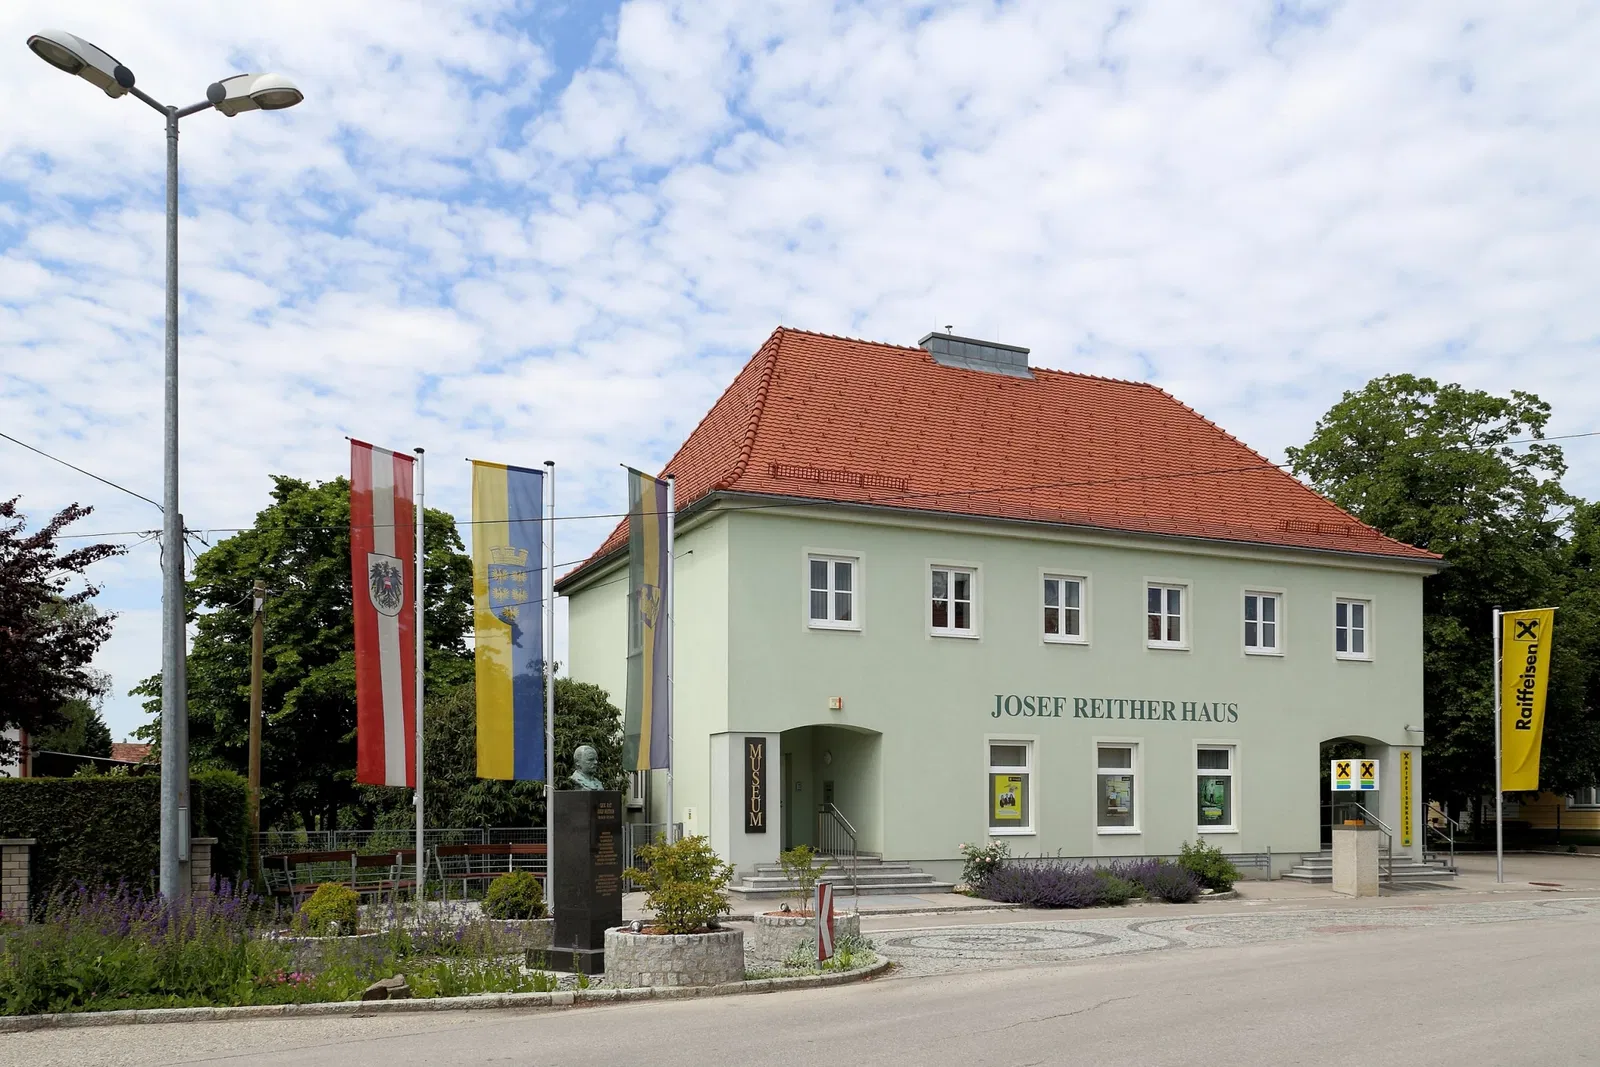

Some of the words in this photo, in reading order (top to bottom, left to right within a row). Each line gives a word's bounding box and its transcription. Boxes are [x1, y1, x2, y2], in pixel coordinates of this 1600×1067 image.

[991, 694, 1067, 719] JOSEF
[1073, 697, 1177, 721] REITHER
[1181, 701, 1239, 723] HAUS
[1515, 644, 1539, 731] Raiffeisen
[749, 743, 763, 827] MUSEUM
